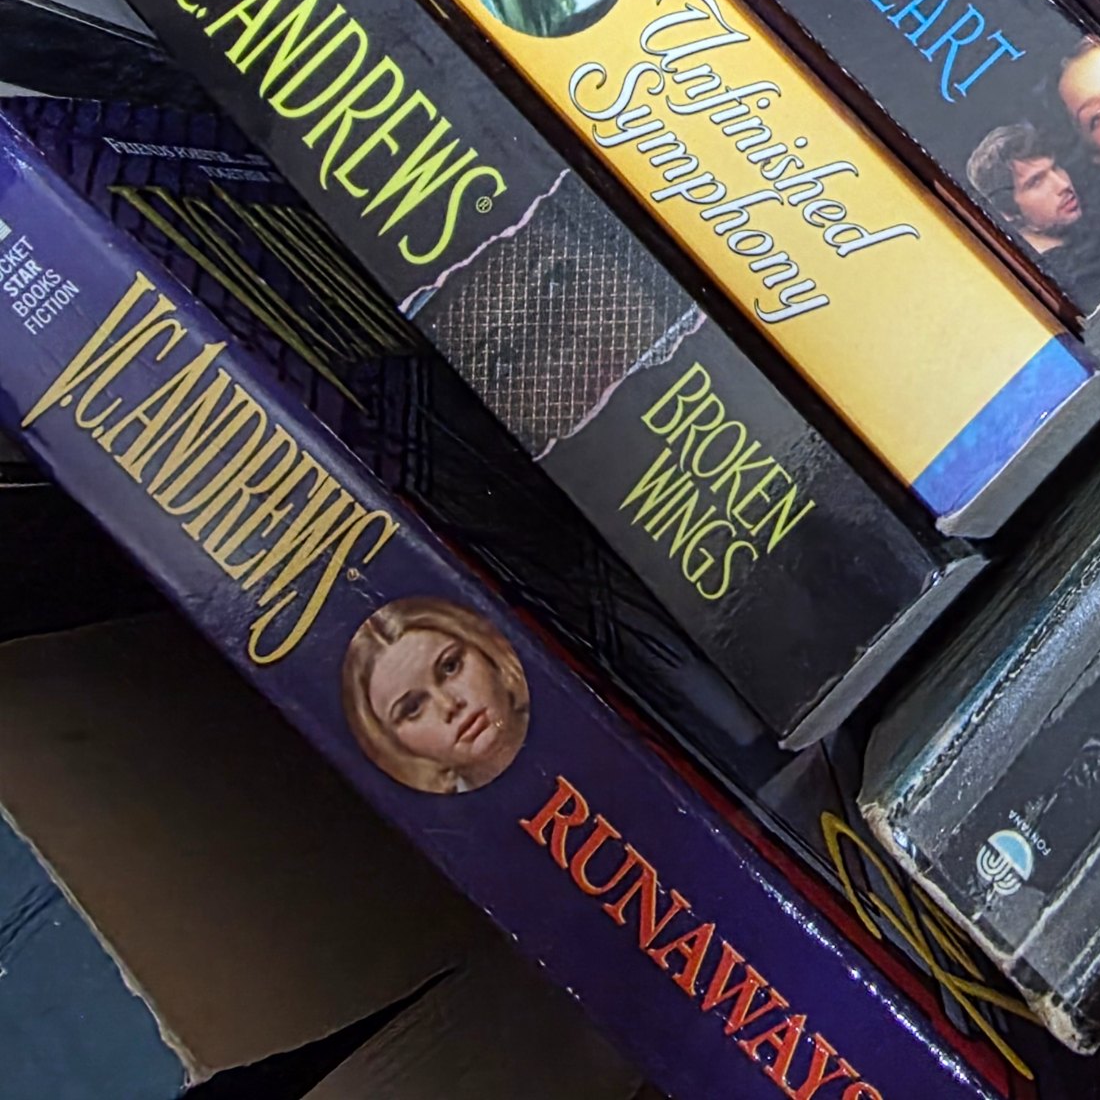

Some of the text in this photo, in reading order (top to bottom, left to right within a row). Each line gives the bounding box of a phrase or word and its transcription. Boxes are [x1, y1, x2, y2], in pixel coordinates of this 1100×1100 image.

[568, 60, 830, 324] Symphony
[3, 259, 42, 297] STAR
[12, 269, 61, 318] BOOKS
[23, 280, 80, 335] FICTION
[641, 361, 816, 555] BROKEN
[619, 447, 759, 600] WINGS
[1008, 809, 1051, 856] FONTANA
